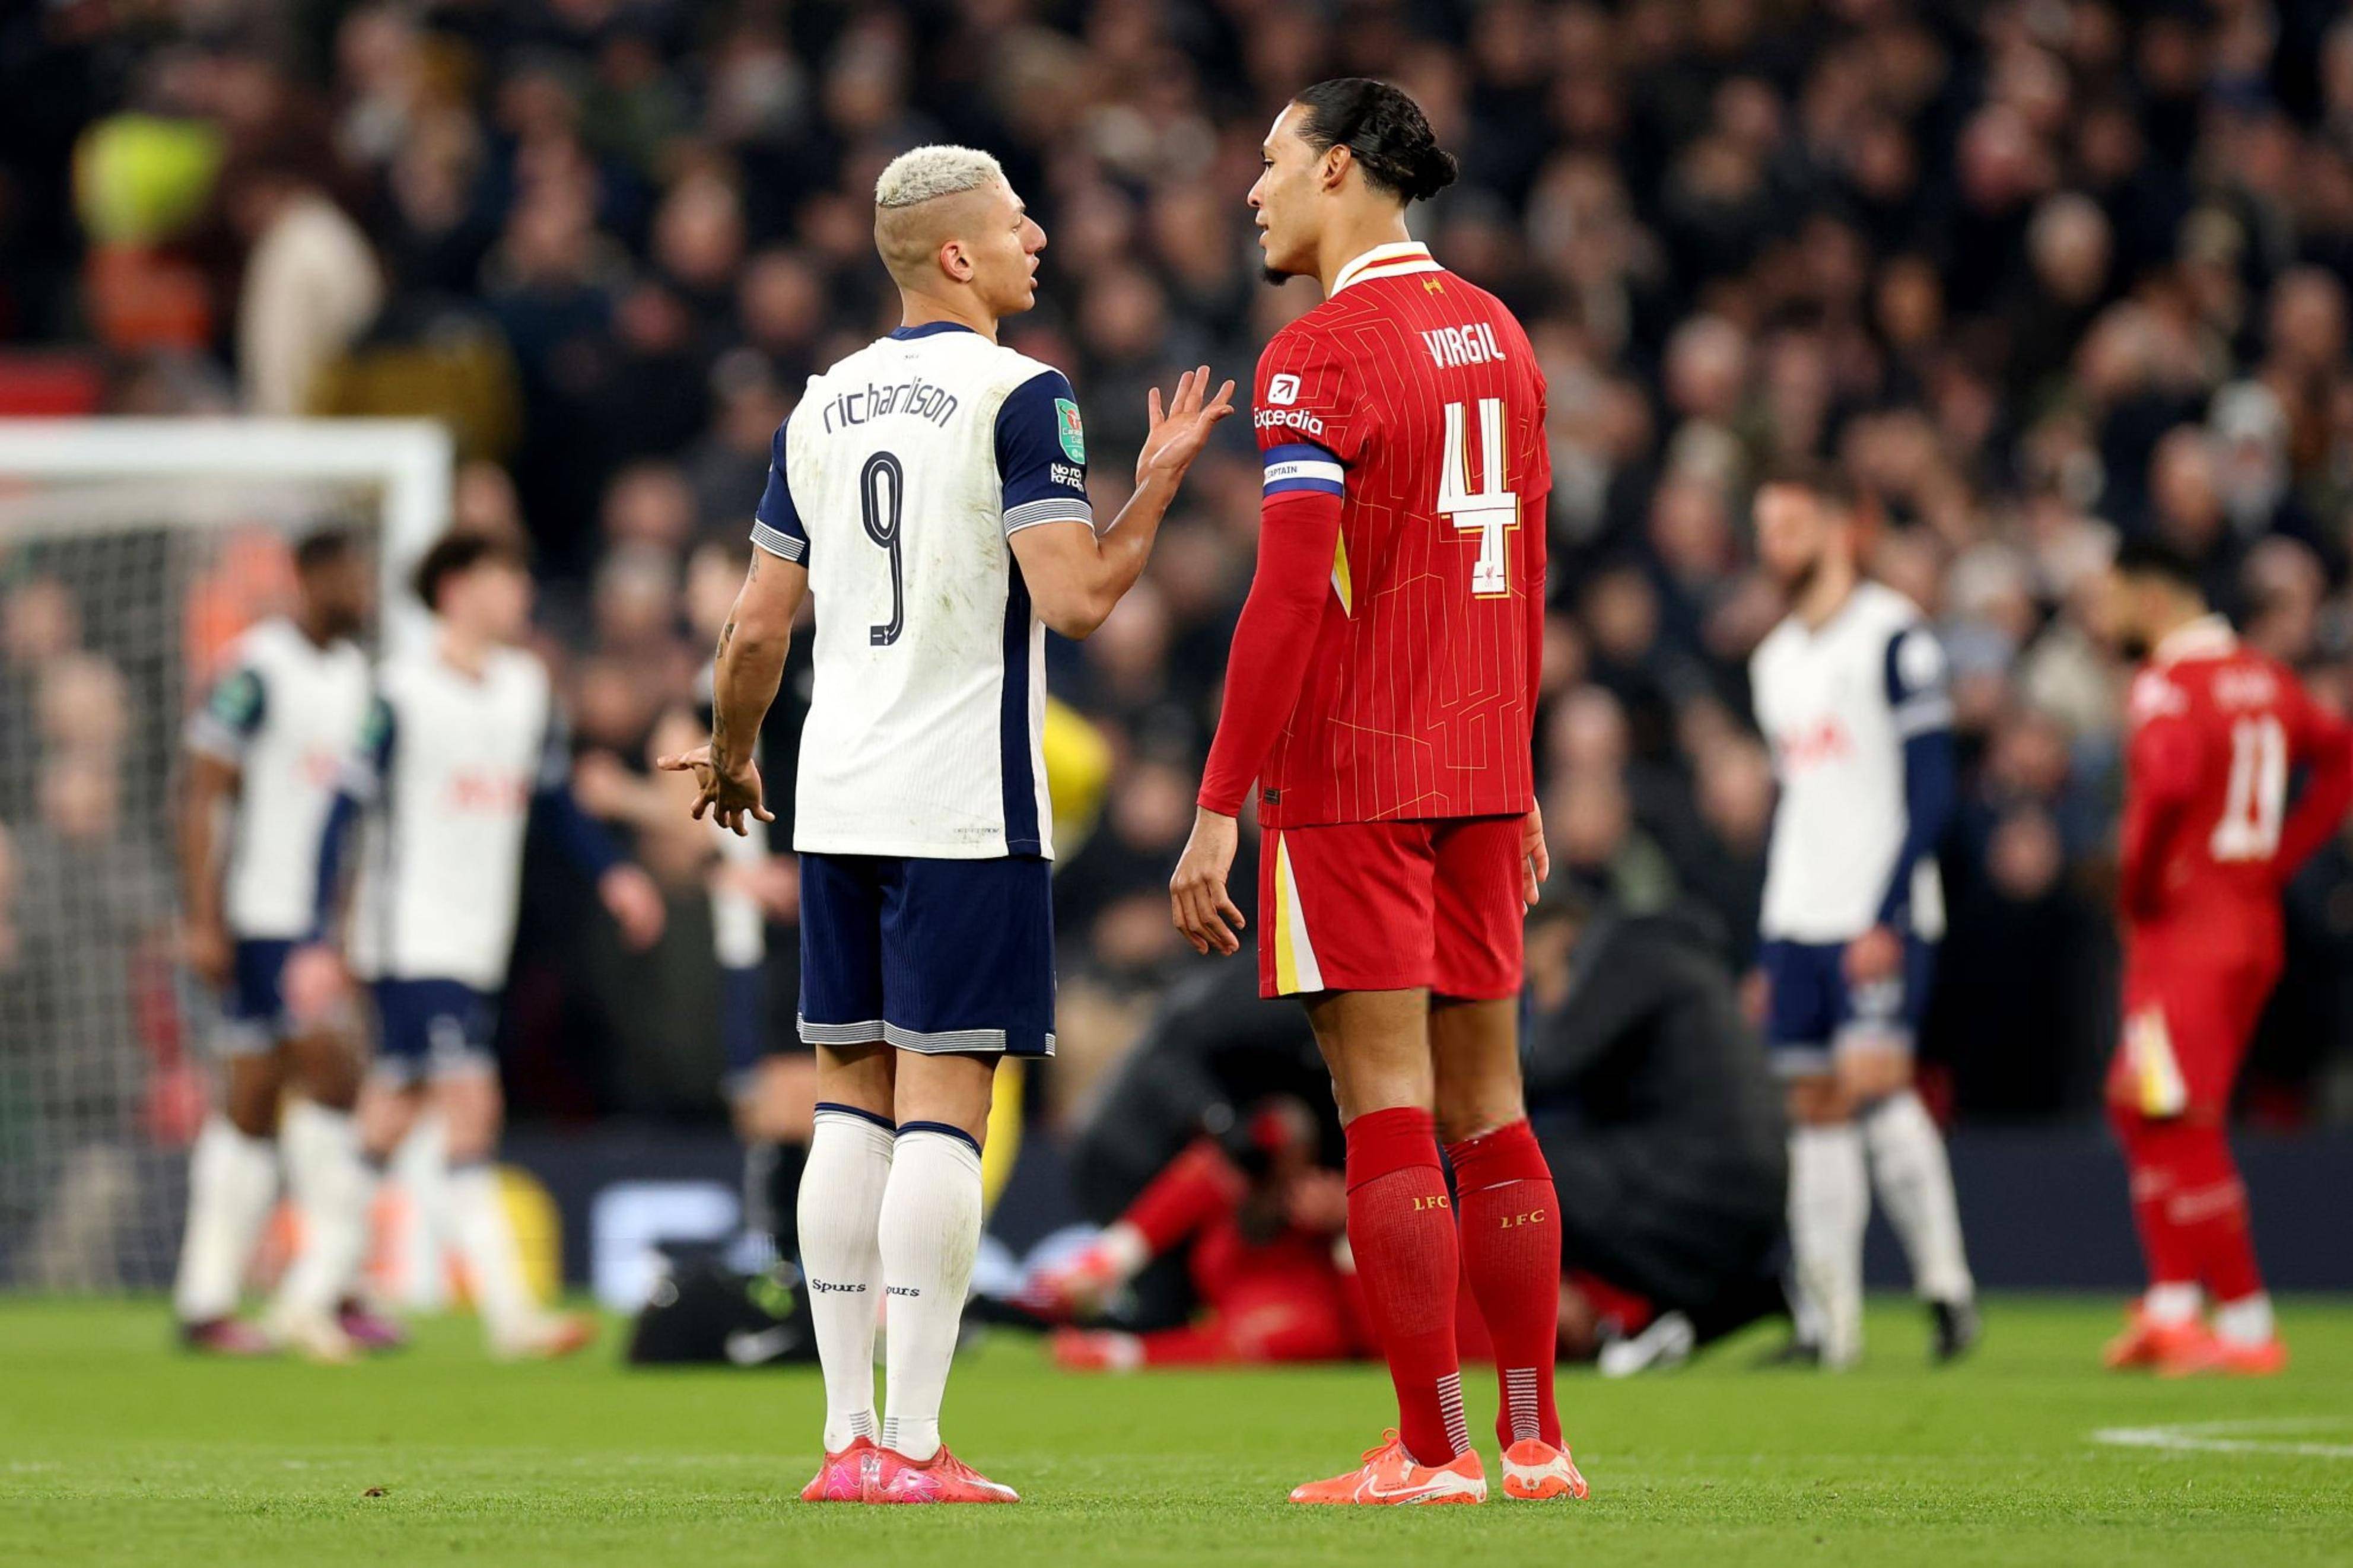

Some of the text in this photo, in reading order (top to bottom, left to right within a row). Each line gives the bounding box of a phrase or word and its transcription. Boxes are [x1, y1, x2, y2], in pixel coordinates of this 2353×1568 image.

[1421, 322, 1506, 369] VIRGIL
[823, 376, 958, 434] richarlison
[1254, 406, 1323, 436] Expedia
[1051, 462, 1069, 475] No
[1267, 466, 1298, 478] CAPTAIN
[1436, 398, 1521, 599] 4
[860, 451, 904, 645] 9
[1413, 1195, 1448, 1210] LFC
[1500, 1209, 1544, 1229] LFC
[812, 1279, 866, 1293] Spurs
[886, 1286, 920, 1297] purs
